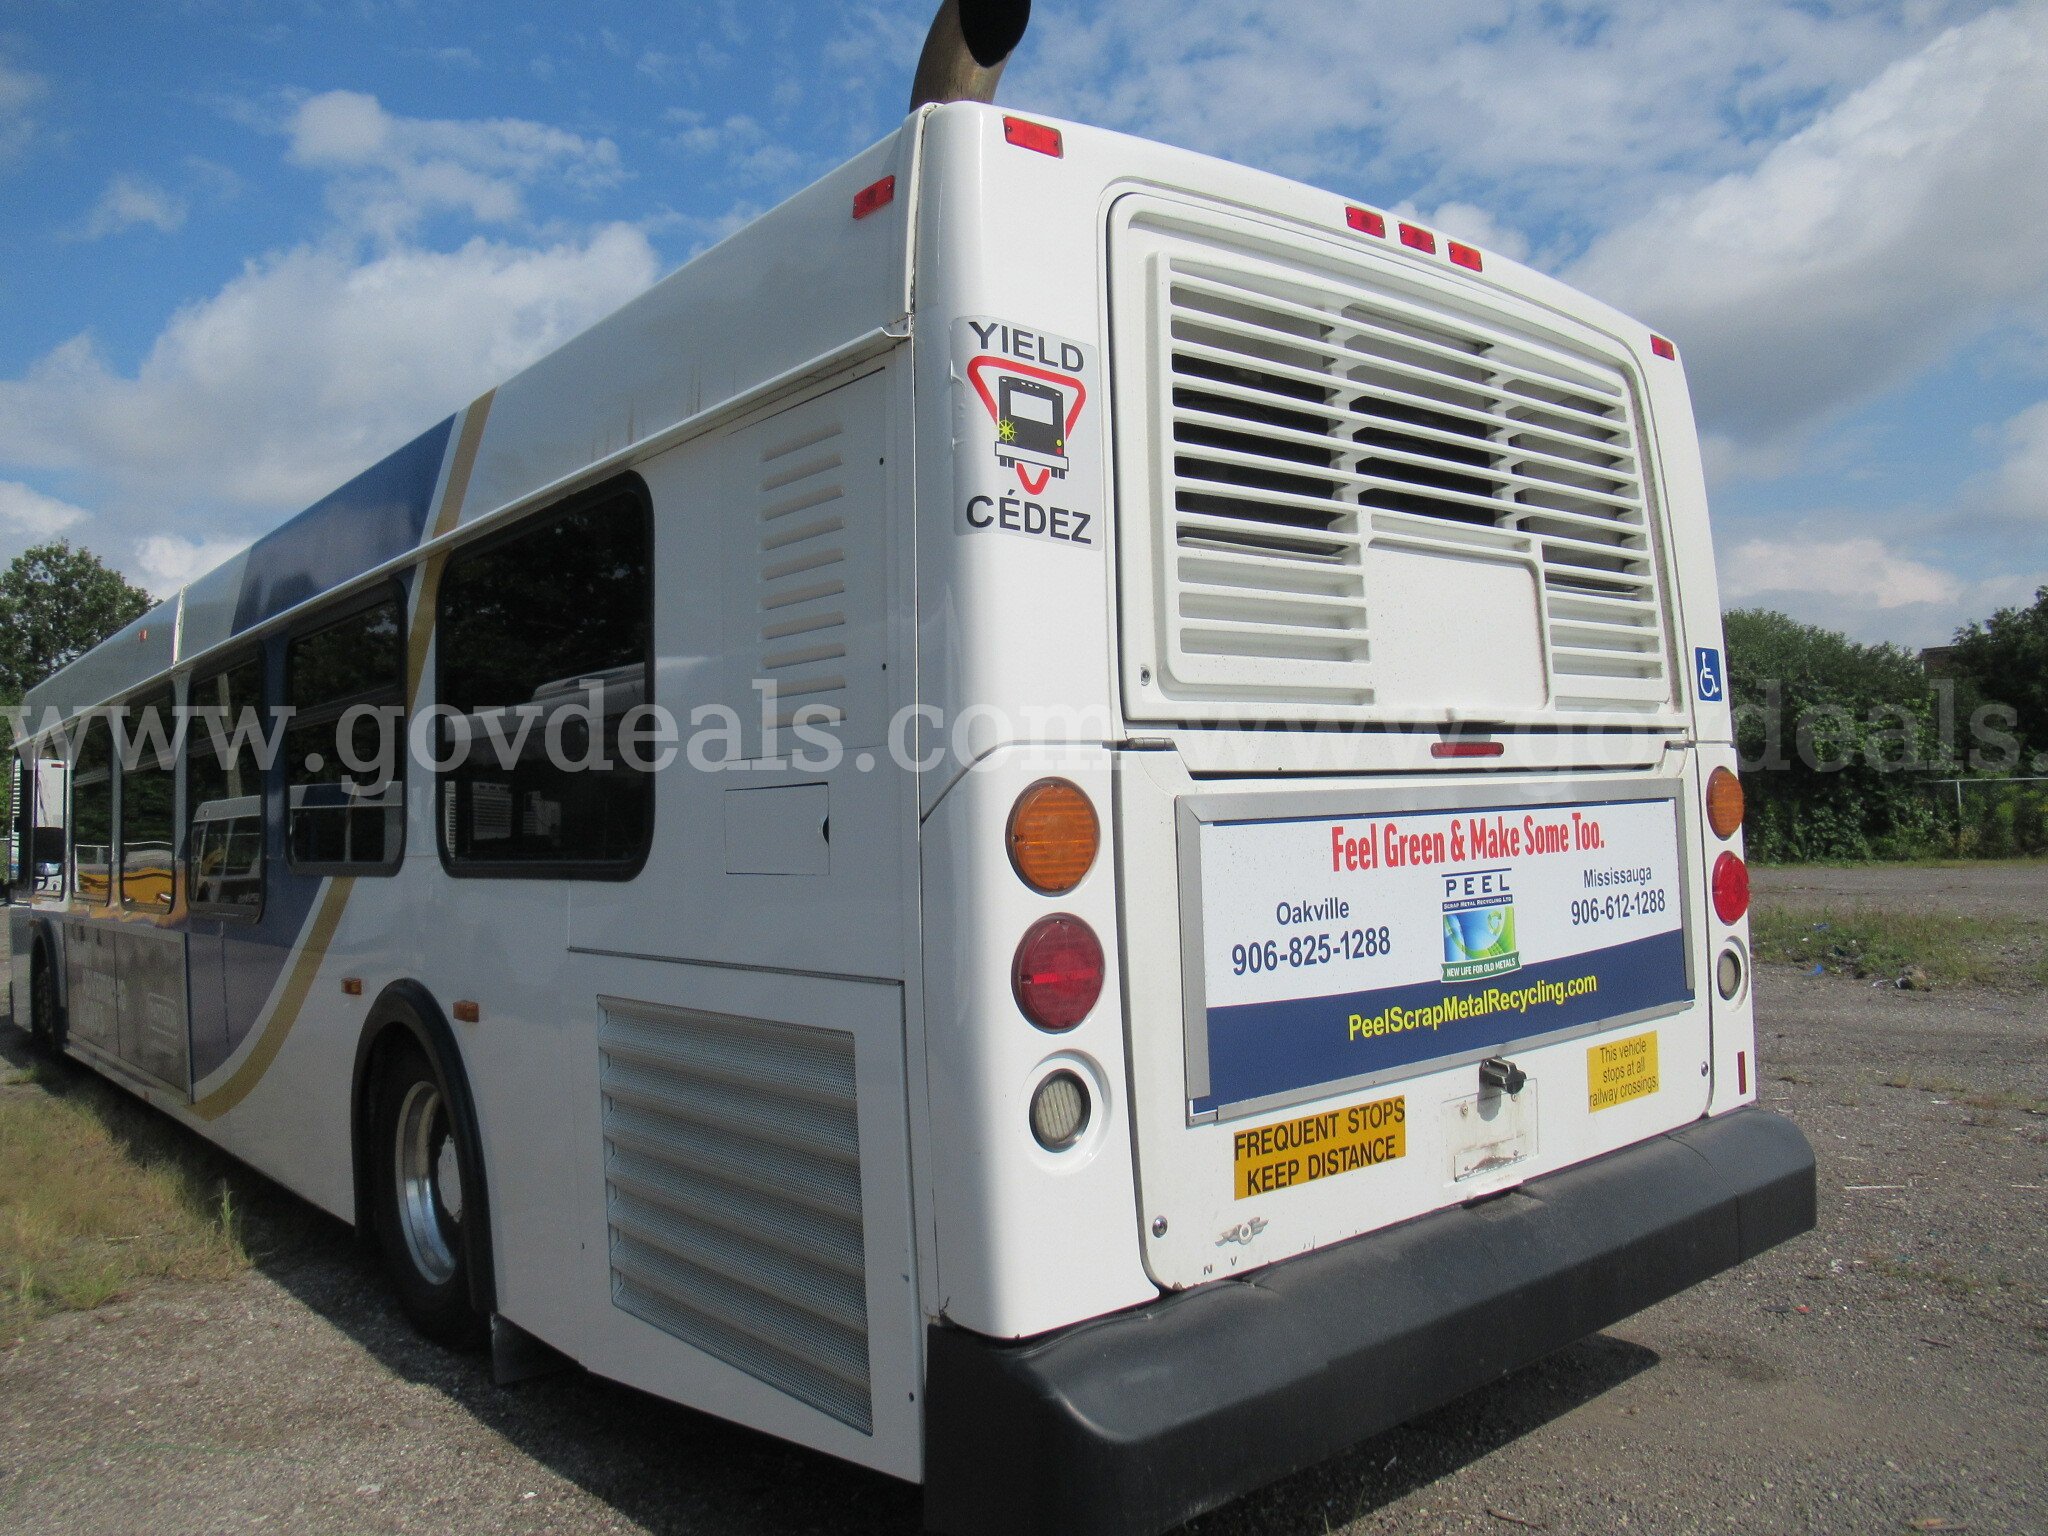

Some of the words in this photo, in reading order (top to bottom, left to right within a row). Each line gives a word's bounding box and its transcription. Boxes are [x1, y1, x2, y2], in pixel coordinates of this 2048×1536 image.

[968, 321, 1084, 373] YIELD
[966, 489, 1092, 545] CÉDEZ
[1332, 823, 1378, 872] Feel
[1384, 823, 1445, 868] Green
[1450, 819, 1466, 862] &
[1469, 816, 1520, 861] Make
[1523, 815, 1569, 856] Some
[1571, 813, 1605, 851] Too.
[1446, 874, 1510, 897] PEEL
[1583, 864, 1653, 889] Mississauga
[1276, 897, 1350, 927] Oakville
[1570, 888, 1666, 926] 906-612-1288
[1231, 926, 1391, 976] 906-825-1288
[1447, 967, 1459, 977] NEW
[1461, 965, 1471, 975] LIFE
[1473, 963, 1483, 974] FOR
[1484, 962, 1495, 972] OLD
[1496, 958, 1516, 969] METALS
[1348, 974, 1597, 1041] PeelScrapMetalRecycling.com
[1600, 1046, 1618, 1063] This
[1620, 1038, 1647, 1058] vehicle
[1603, 1065, 1625, 1085] stops
[1627, 1060, 1635, 1076] at
[1636, 1056, 1646, 1074] all
[1590, 1088, 1618, 1108] railway
[1620, 1075, 1659, 1098] crossings.
[1234, 1110, 1338, 1162] FREQUENT
[1348, 1099, 1406, 1134] STOPS
[1247, 1159, 1299, 1196] KEEP
[1308, 1134, 1396, 1178] DISTANCE
